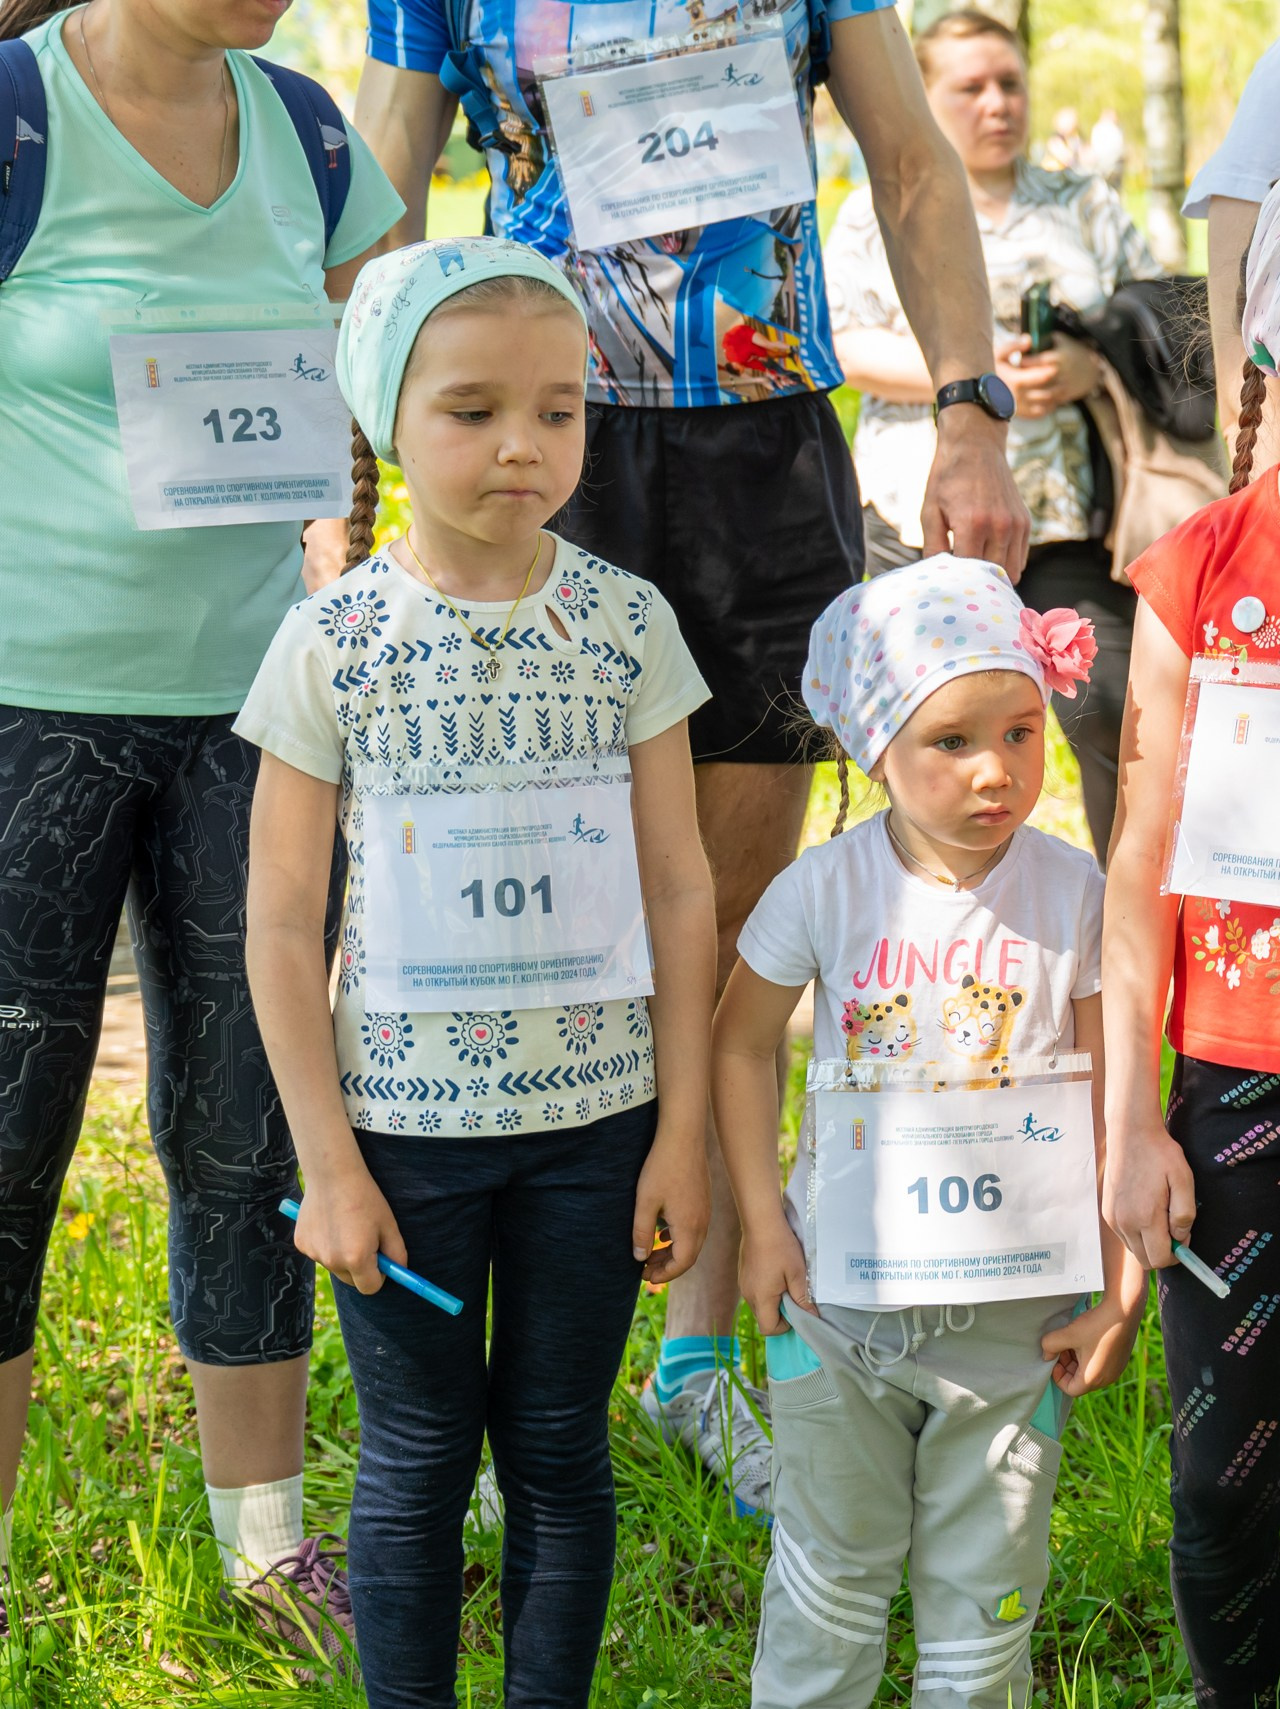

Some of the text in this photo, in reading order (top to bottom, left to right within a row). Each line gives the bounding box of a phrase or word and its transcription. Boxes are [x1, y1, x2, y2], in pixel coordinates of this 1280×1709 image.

[637, 120, 719, 164] 204
[203, 406, 282, 444] 123
[164, 478, 329, 496] СОРЕВНОВАНИЯ ПО СПОРТИВНОМУ ОРИЕНТИРОВАНИЮ
[174, 498, 184, 507] НА
[185, 496, 220, 506] ОТКРЫТЫЙ
[221, 495, 241, 504] КУБОК
[260, 491, 291, 502] КОЛПИНО
[292, 490, 307, 500] 2024
[308, 489, 324, 499] ГОДА
[1212, 852, 1274, 869] СОРЕВНОВАНИЯ
[1220, 865, 1232, 876] НА
[1233, 866, 1276, 881] ОТКРЫТЫЙ
[461, 874, 553, 918] 101
[402, 953, 604, 976] СОРЕВНОВАНИЯ ПО СПОРТИВНОМУ ОРИЕНТИРОВАНИЮ
[412, 977, 423, 987] НА
[425, 976, 469, 987] ОТКРЫТЫЙ
[470, 976, 496, 986] КУБОК
[498, 975, 511, 985] МО
[561, 969, 578, 980] 2024
[579, 968, 597, 979] ГОДА
[853, 937, 1028, 989] JUNGLE
[1220, 1072, 1268, 1103] UNICOR
[1214, 1119, 1273, 1163] FOREVER
[907, 1173, 1003, 1214] 106
[850, 1250, 1051, 1269] СОРЕВНОВАНИЯ ПО СПОРТИВНОМУ ОРИЕНТИРОВАНИЮ
[1214, 1229, 1258, 1276] NICORN
[859, 1263, 1042, 1280] НА ОТКРЫТЫЙ КУБОК МО Г. КОЛПИНО 2024 ГОДА
[1221, 1294, 1269, 1352] FOREVER
